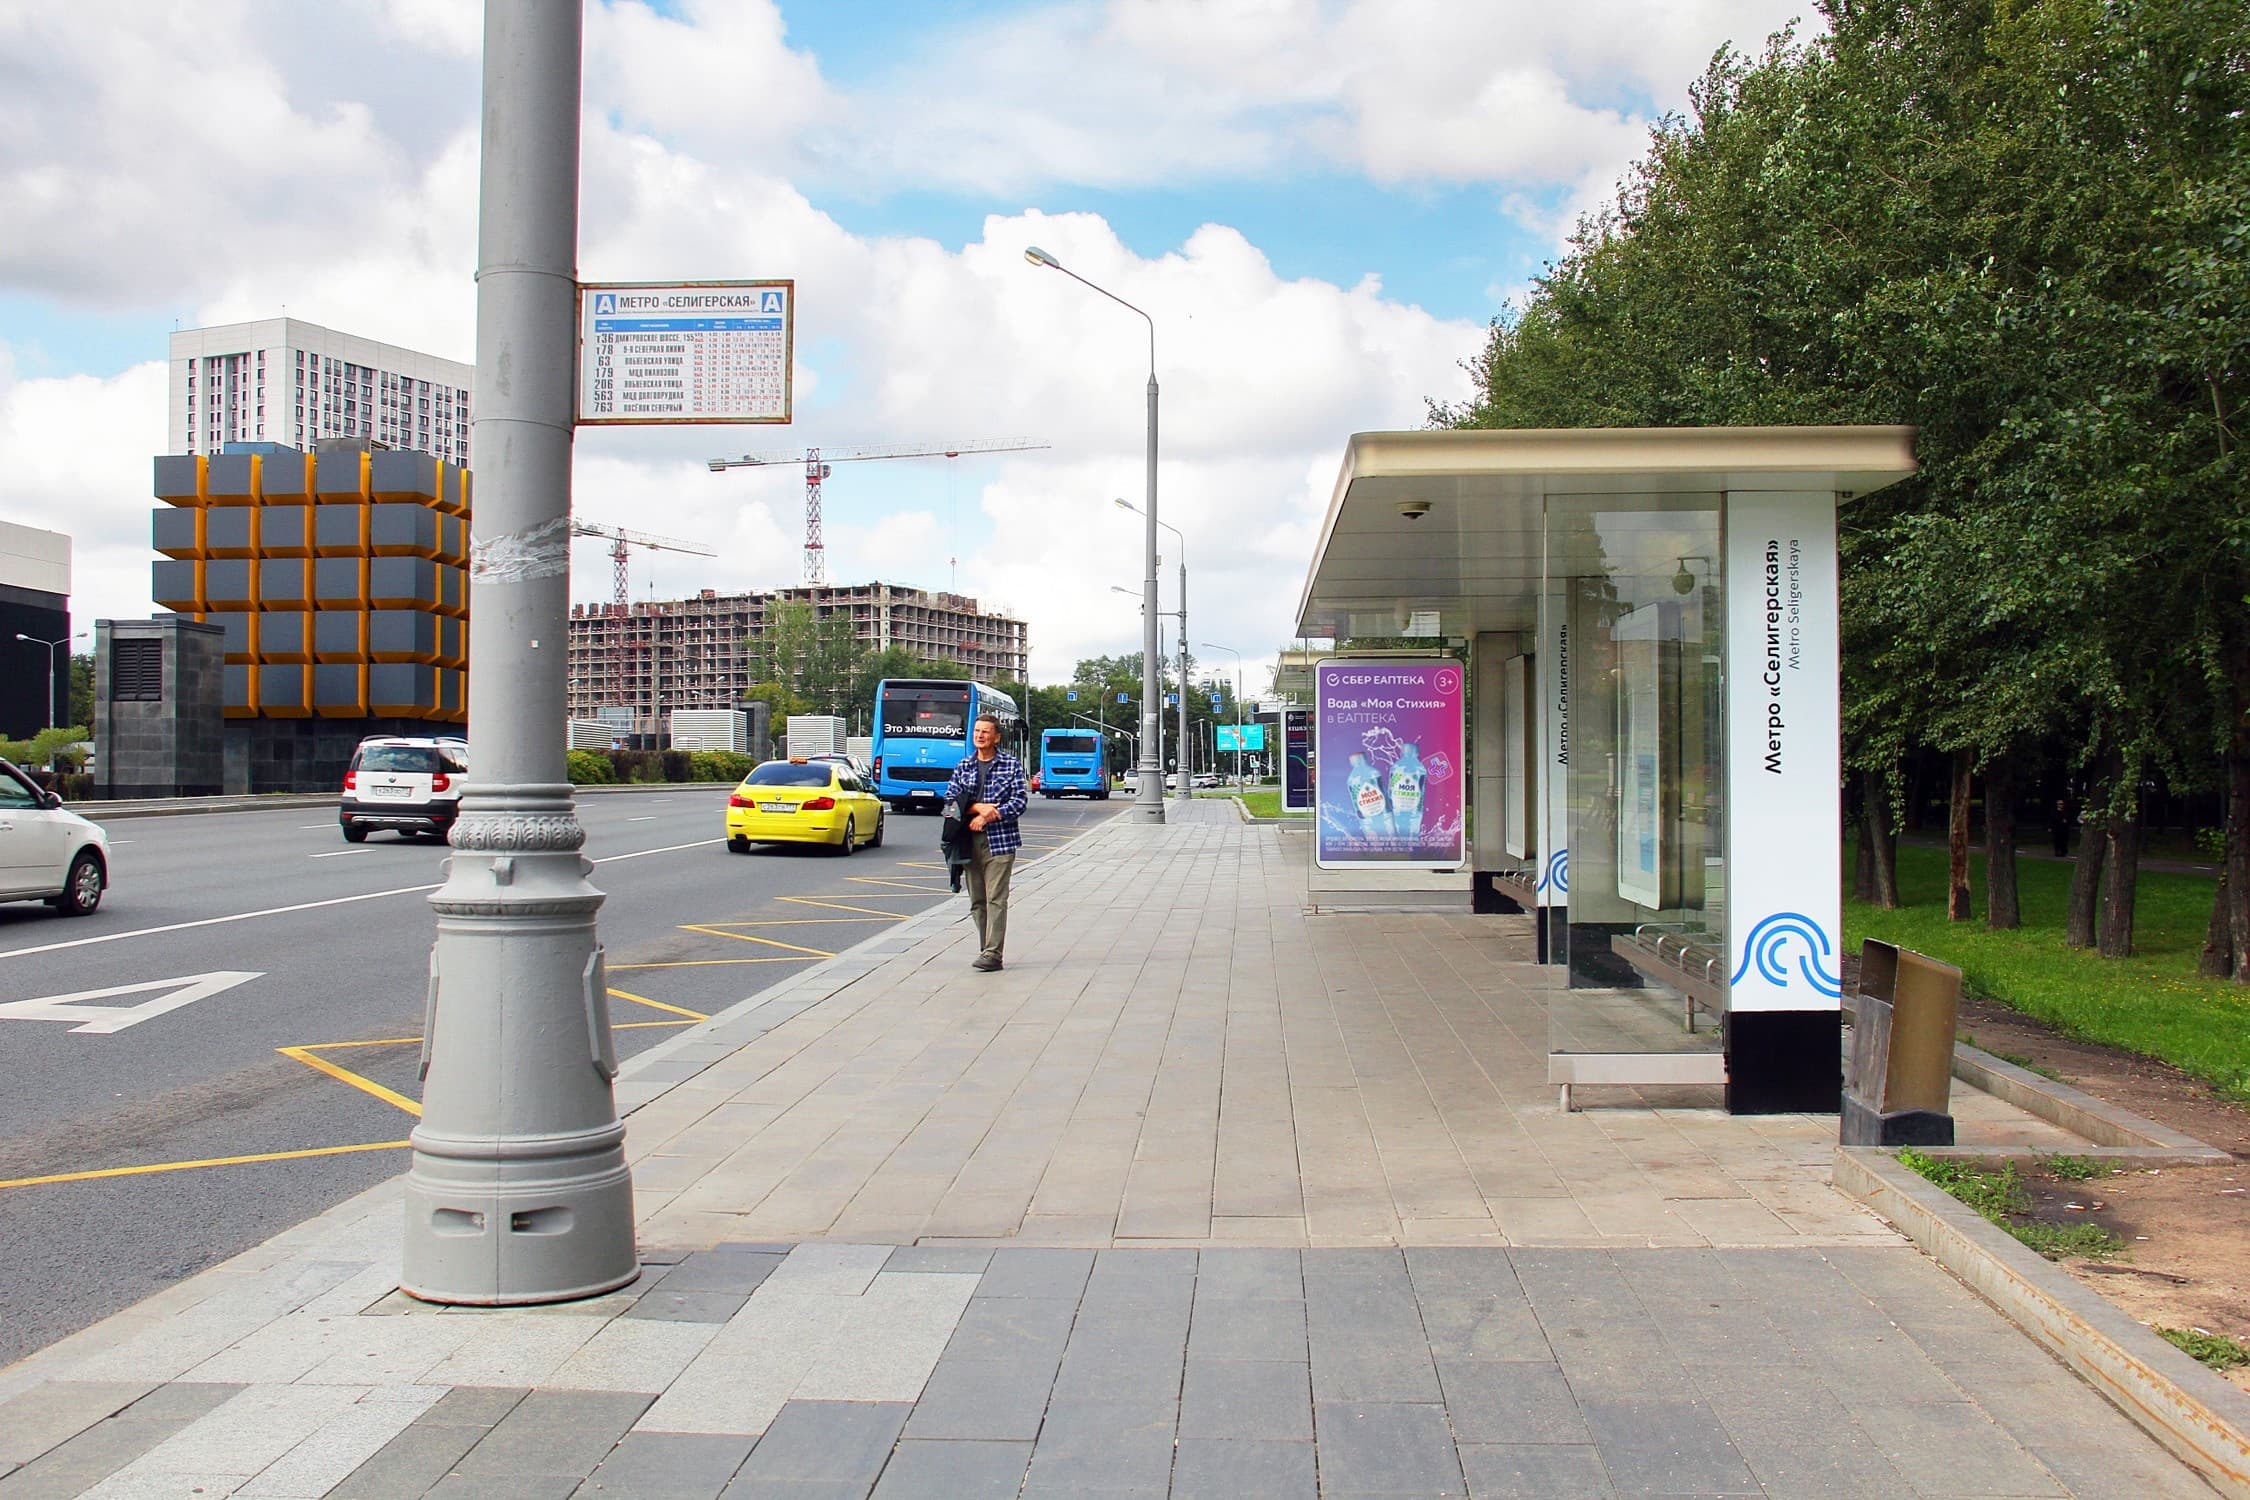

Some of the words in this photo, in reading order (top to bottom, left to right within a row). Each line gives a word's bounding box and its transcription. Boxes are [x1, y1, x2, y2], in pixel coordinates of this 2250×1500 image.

[620, 297, 660, 308] МЕТРО
[662, 296, 756, 308] «СЕЛИГЕРСКАЯ»
[683, 333, 694, 341] 155
[598, 356, 611, 366] 63
[596, 367, 614, 378] 179
[595, 379, 614, 389] 206
[594, 391, 613, 401] 563
[594, 402, 613, 412] 763
[1786, 539, 1802, 624] Seligerskaya
[1763, 539, 1783, 697] «Селигерская»
[1788, 627, 1800, 670] Metro
[1342, 675, 1372, 685] СБЕР
[1373, 675, 1425, 685] ЕАПТЕКА
[1439, 677, 1453, 687] 3+
[1327, 698, 1358, 710] Вода
[1360, 698, 1393, 709] «Моя
[1396, 698, 1446, 709] Стихия»
[1327, 715, 1334, 723] в
[1337, 713, 1397, 724] ЕАПТЕКА
[884, 723, 903, 733] Это
[904, 725, 965, 737] электробус.
[1764, 703, 1785, 774] Метро
